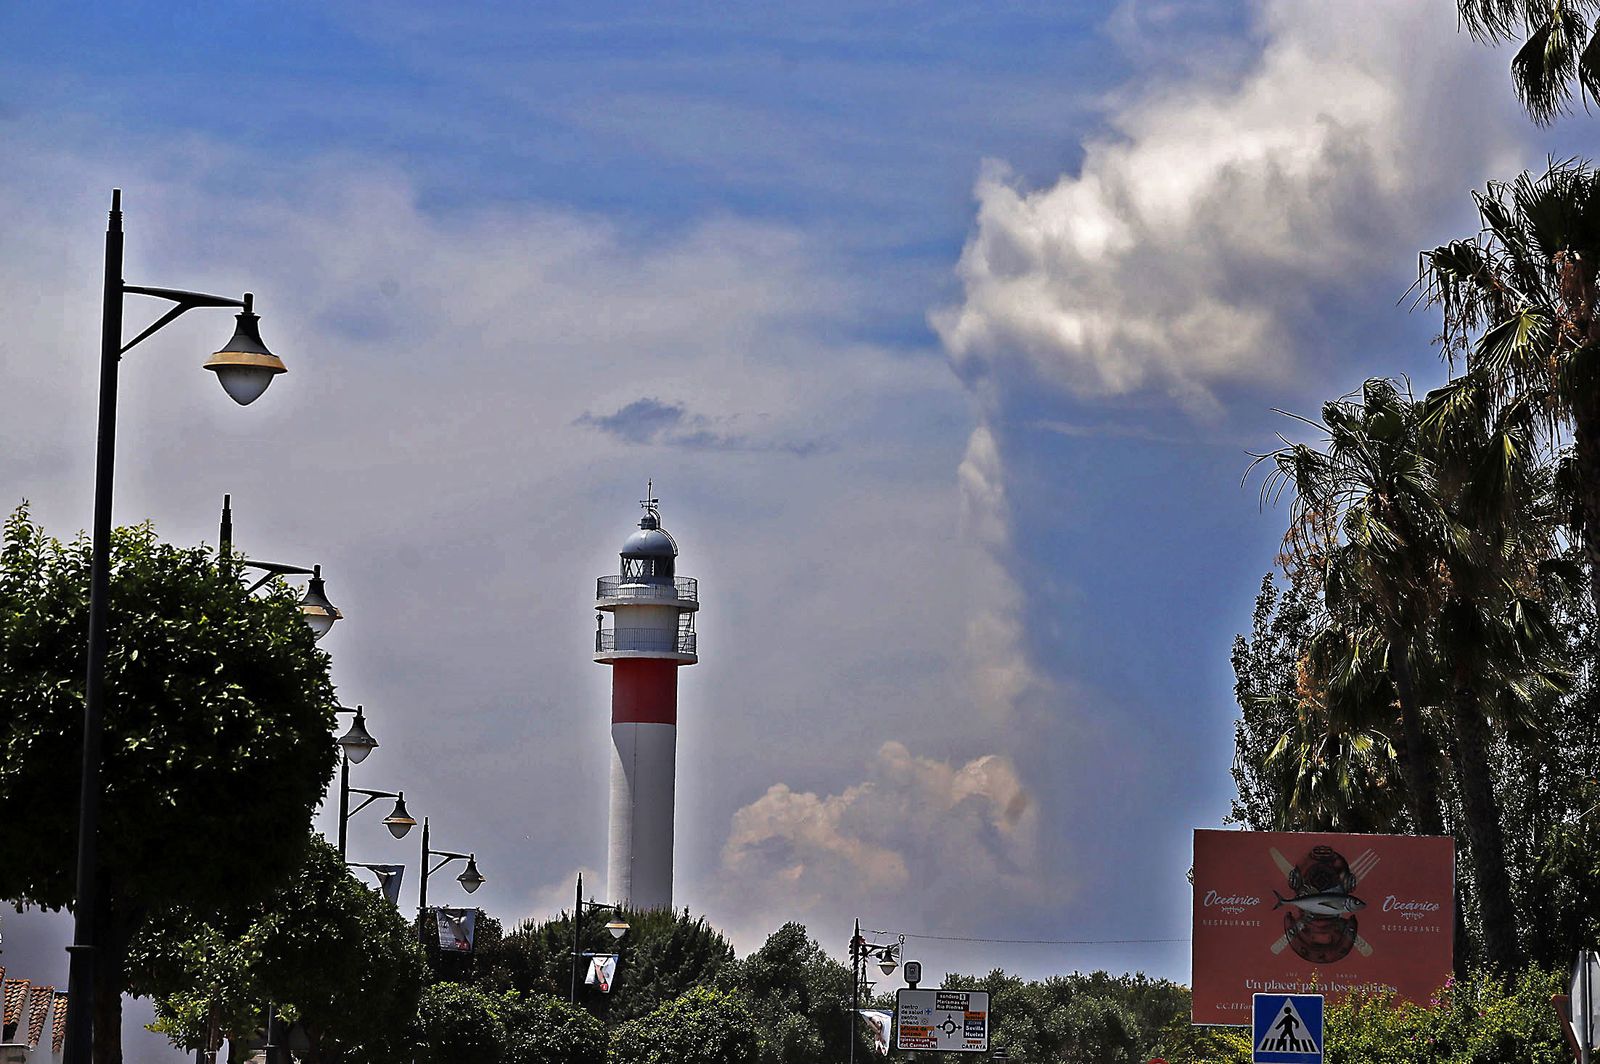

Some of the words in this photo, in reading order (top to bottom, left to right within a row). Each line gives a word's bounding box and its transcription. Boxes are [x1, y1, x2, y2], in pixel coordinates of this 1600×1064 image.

[1203, 890, 1261, 907] Oceánico
[1382, 895, 1440, 912] Oceánico
[1202, 919, 1261, 927] RESTAURANTE
[1382, 924, 1441, 933] RESTAURANTE
[1246, 979, 1261, 989] Un
[1264, 980, 1297, 992] placer
[1331, 981, 1348, 992] los
